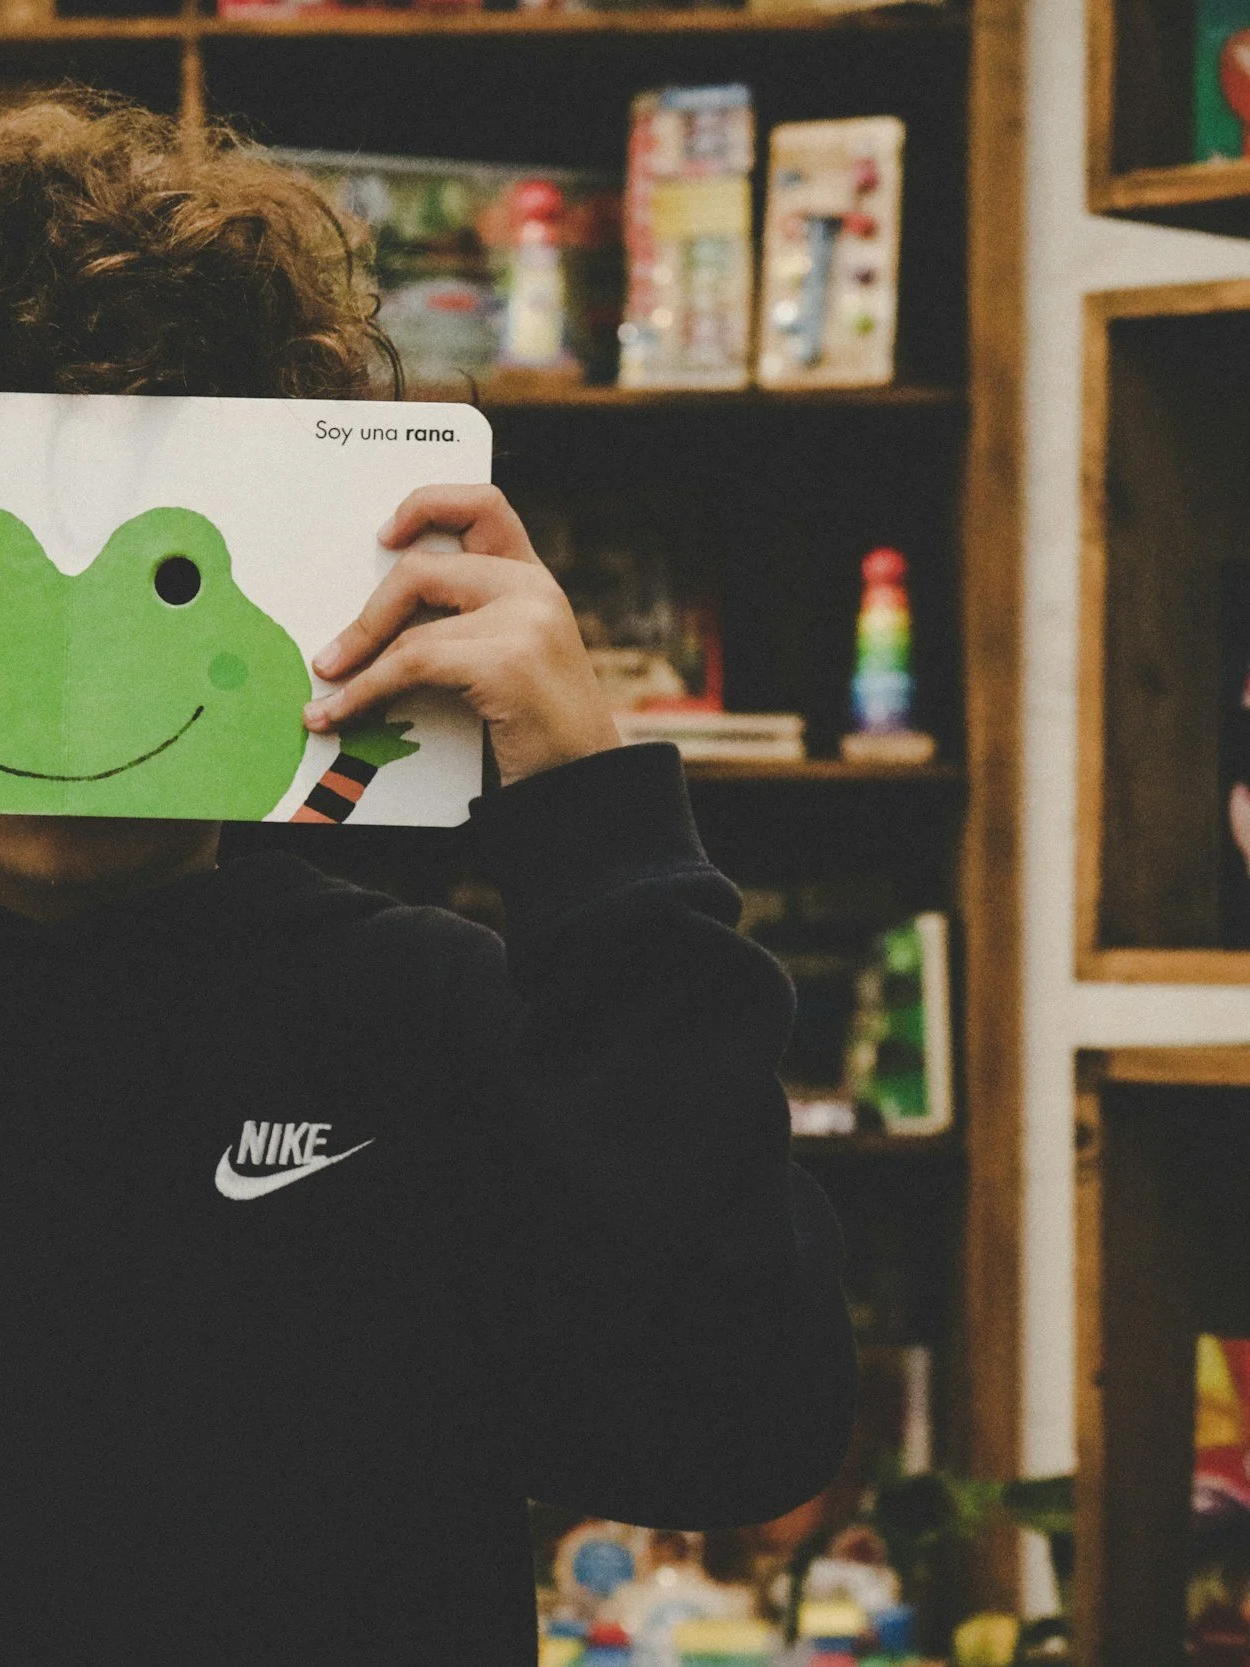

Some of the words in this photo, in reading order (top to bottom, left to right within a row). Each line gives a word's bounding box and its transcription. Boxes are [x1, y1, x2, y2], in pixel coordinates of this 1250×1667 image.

[315, 420, 353, 446] Soy
[360, 428, 398, 441] una
[406, 428, 461, 442] rana.
[237, 1120, 332, 1165] NIKE
